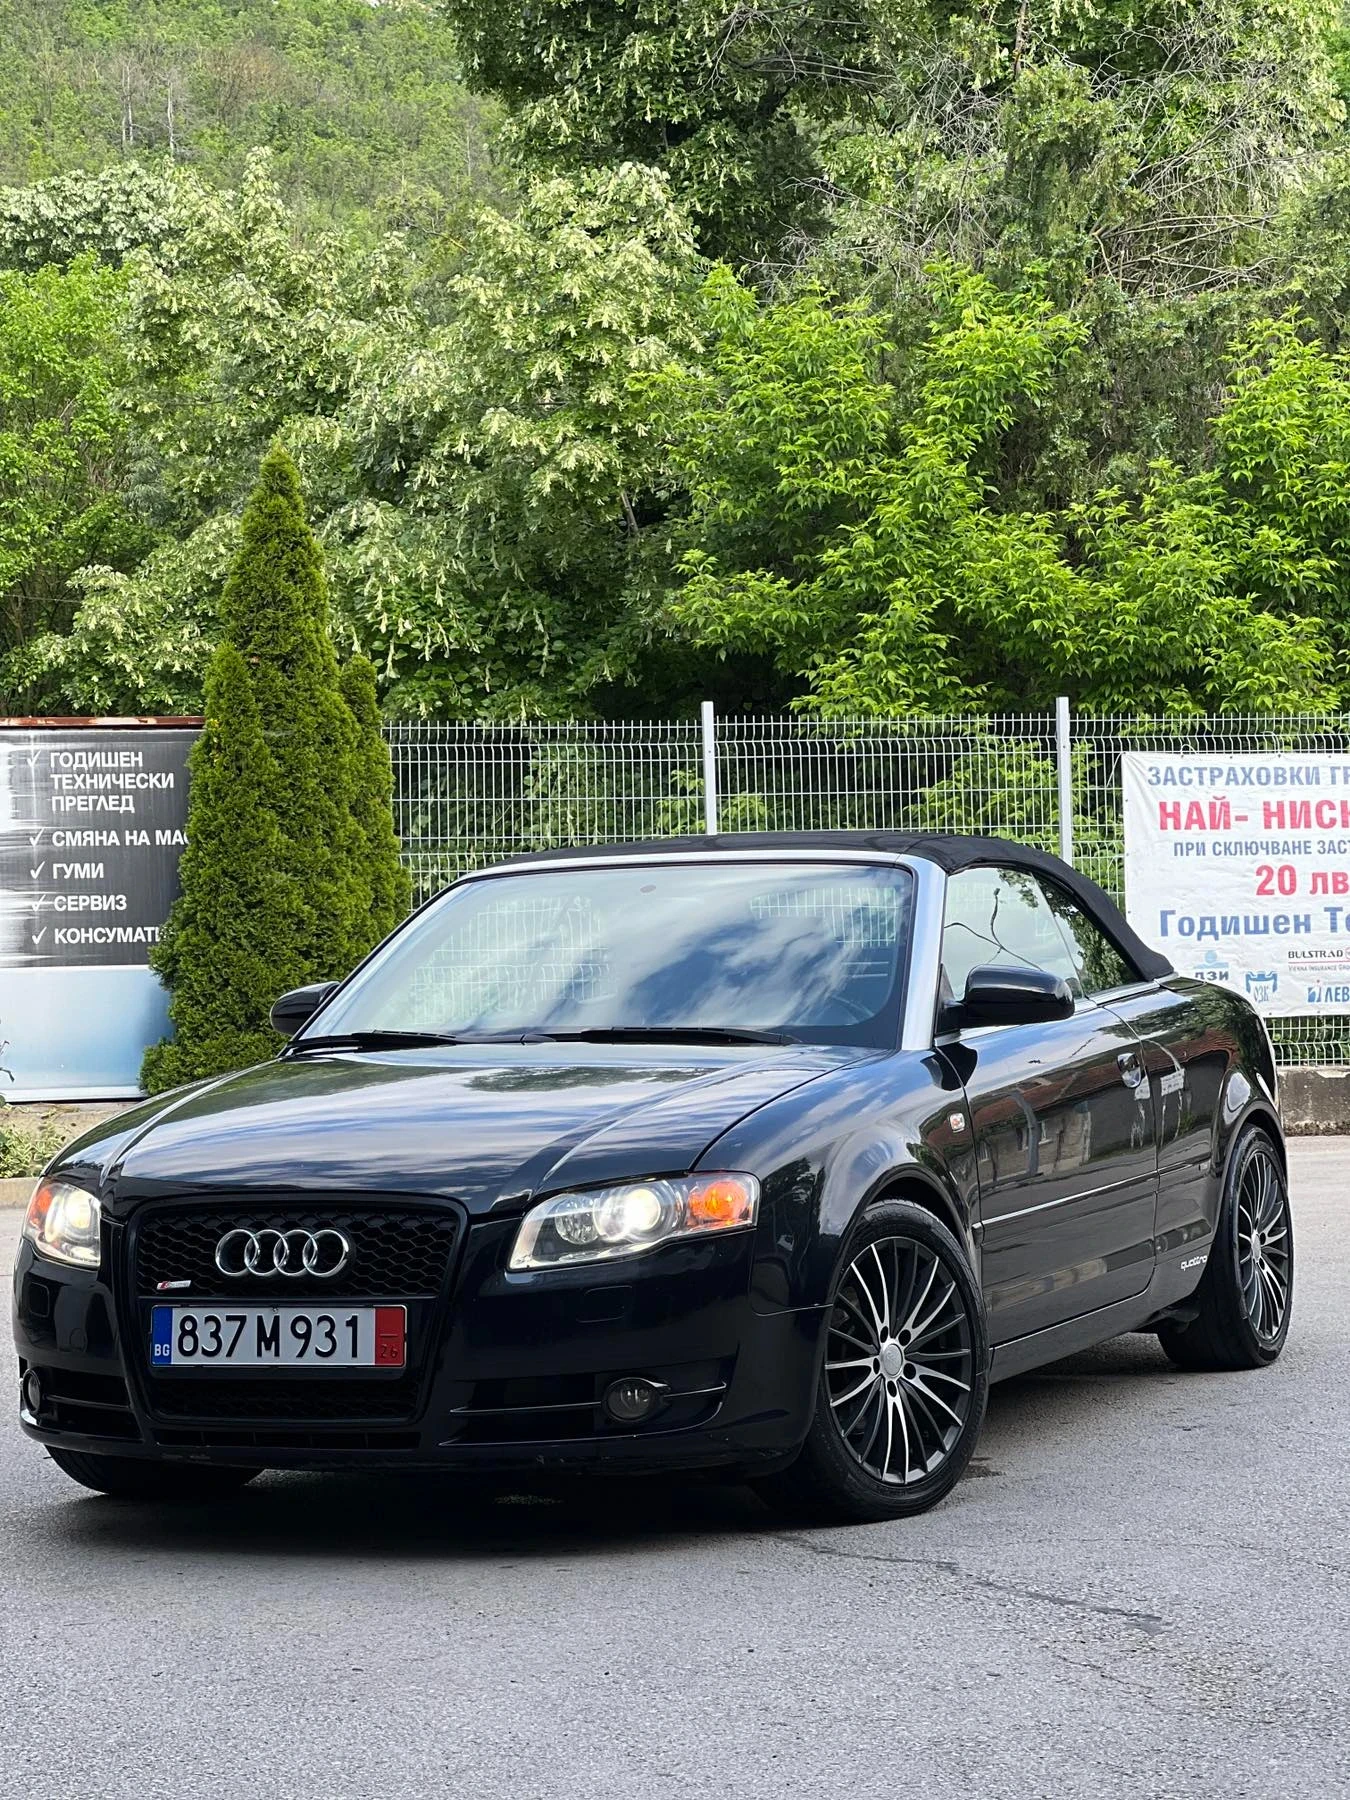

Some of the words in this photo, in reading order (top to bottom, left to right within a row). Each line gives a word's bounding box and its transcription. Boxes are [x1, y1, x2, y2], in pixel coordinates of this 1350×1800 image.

[50, 751, 143, 770] ГОДИШЕН
[50, 773, 174, 789] ТЕХНИЧЕСКИ
[1148, 766, 1320, 786] ЗАСТРАХОВКИ
[51, 795, 135, 814] ПРЕГЛЕД
[52, 830, 120, 847] СМЯНА
[125, 830, 151, 846] НА
[1174, 842, 1206, 857] ПРИ
[1212, 840, 1312, 857] СКЛЮЧВАНЕ
[1317, 839, 1350, 855] ЗАС
[52, 862, 104, 880] ГУМИ
[1256, 864, 1297, 896] 20
[54, 895, 127, 911] СЕРВИЗ
[1159, 909, 1312, 941] Годишен
[1288, 950, 1343, 959] BULSTRAD
[1180, 1255, 1208, 1272] quattro
[154, 1343, 170, 1356] BG
